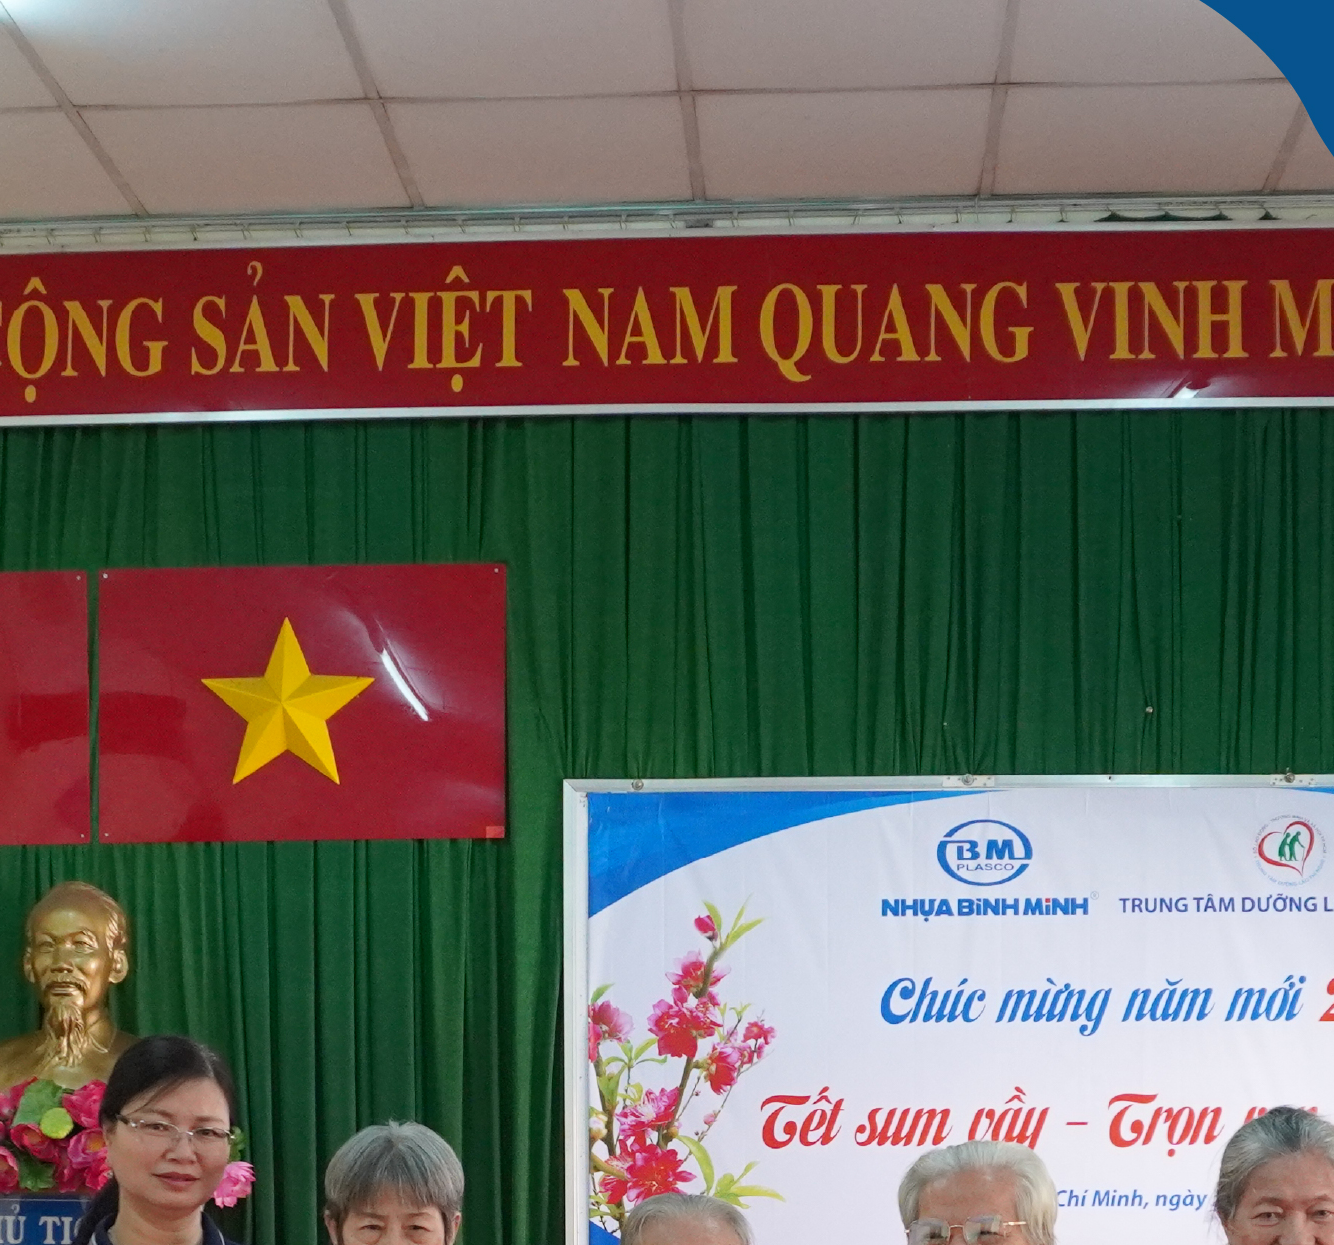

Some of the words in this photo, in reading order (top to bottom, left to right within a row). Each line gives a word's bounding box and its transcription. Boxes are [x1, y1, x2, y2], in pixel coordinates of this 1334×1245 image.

[191, 262, 334, 377] SẢN
[355, 265, 532, 392] VIỆT
[561, 286, 738, 366] NAM
[760, 281, 1033, 383] QUANG
[1055, 279, 1248, 361] VINH
[957, 863, 1014, 871] PLASCO
[882, 898, 954, 922] NHỰA
[1119, 897, 1188, 913] TRUNG
[1193, 893, 1236, 913] TÂM
[1242, 892, 1318, 913] DƯỠNG
[880, 976, 986, 1025] Chúc
[995, 977, 1111, 1036] mừng
[1122, 978, 1215, 1022] năm
[1225, 975, 1307, 1022] mới
[760, 1086, 845, 1149] Tết
[854, 1106, 952, 1147] sum
[1108, 1093, 1225, 1157] Trọn
[1057, 1189, 1089, 1207] Chí
[1092, 1189, 1150, 1210] Minh,
[1155, 1190, 1207, 1212] ngày
